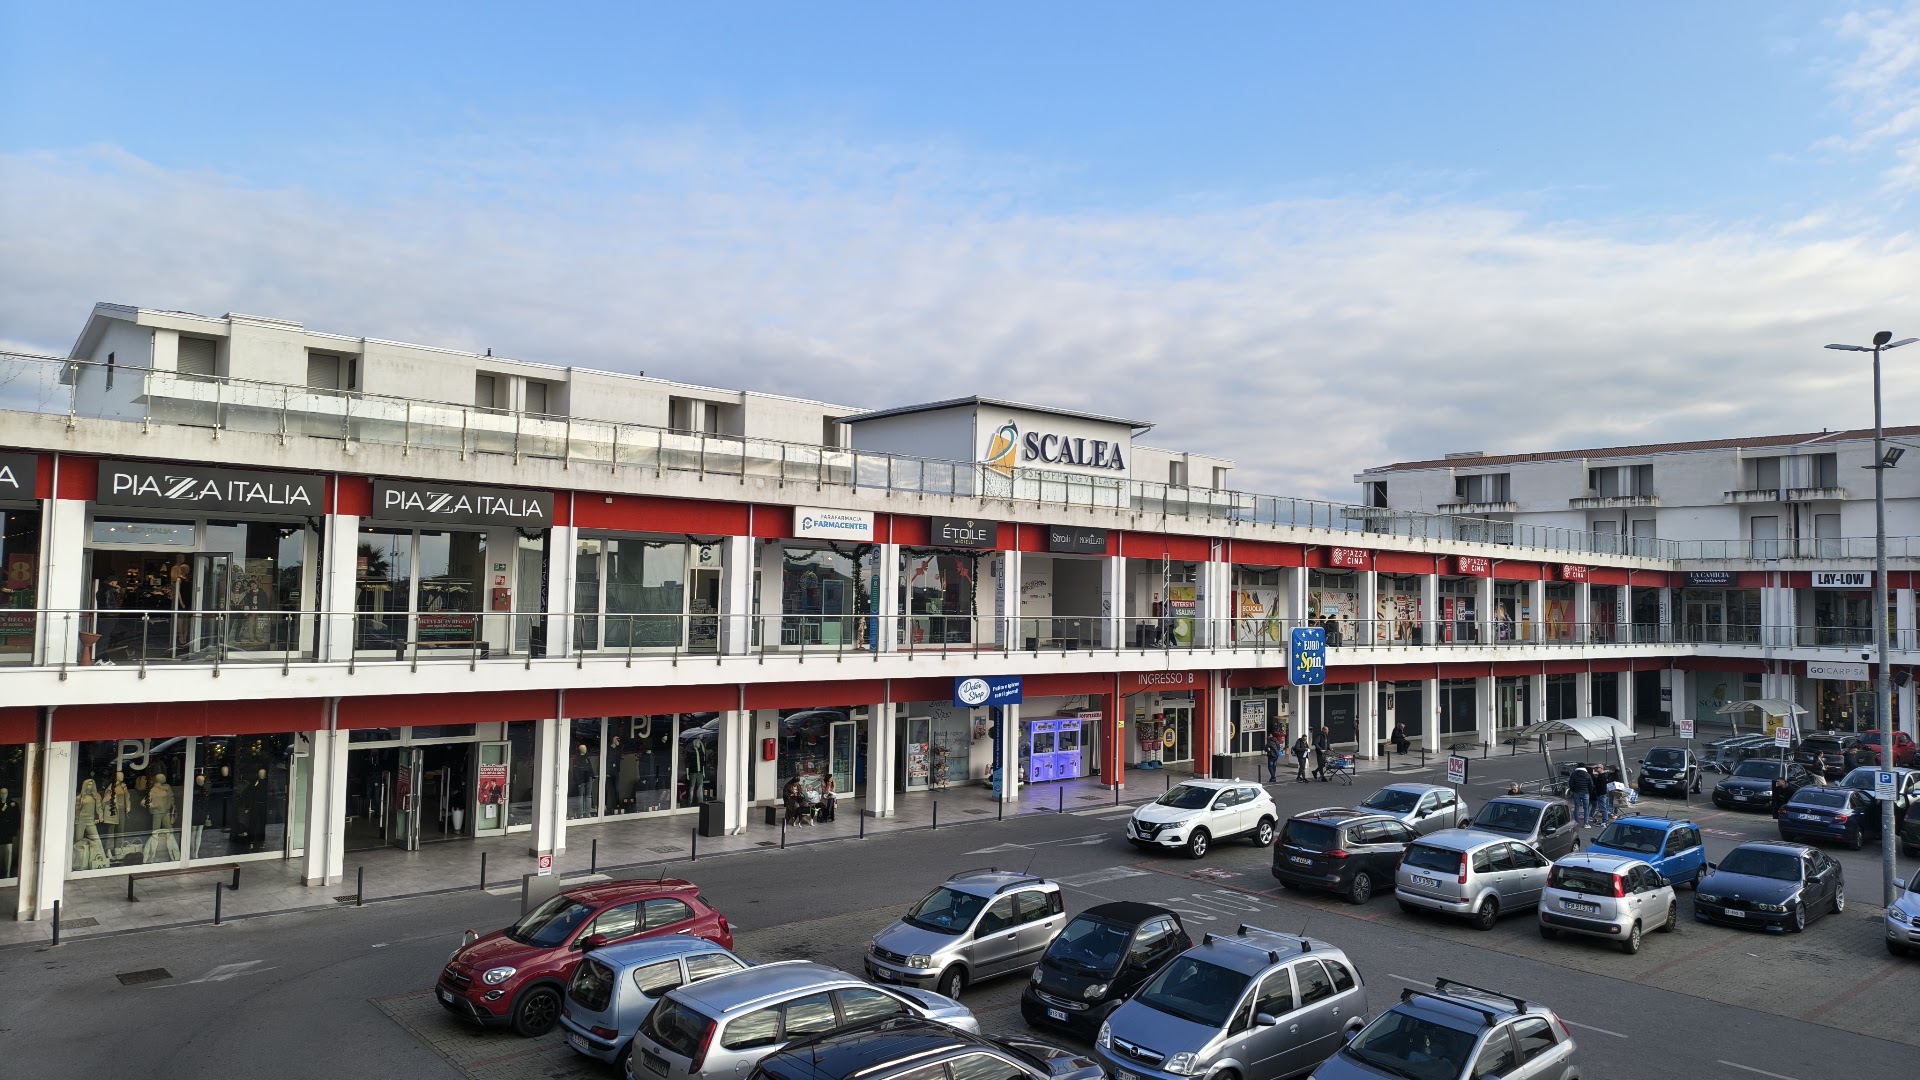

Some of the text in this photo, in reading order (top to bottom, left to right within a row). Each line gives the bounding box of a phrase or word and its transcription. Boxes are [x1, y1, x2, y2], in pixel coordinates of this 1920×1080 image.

[1022, 431, 1126, 470] SCALEA
[1028, 469, 1127, 488] SHOPPNG VLLAGE
[113, 473, 311, 506] PIAZZA ITALIA
[385, 489, 543, 518] PIAZZA ITALIA
[820, 514, 862, 522] PARAFARMACIA
[813, 520, 868, 530] FARMACENTER
[943, 523, 987, 541] ÉTOILE
[1342, 549, 1368, 558] PIAZZA
[1347, 557, 1364, 565] CINA
[1467, 558, 1488, 566] PIAZZA
[12, 561, 31, 582] 8
[1471, 565, 1485, 573] CINA
[1570, 565, 1587, 573] PIAZZA
[1818, 573, 1865, 585] LAY-LOW
[1242, 604, 1263, 612] SCUOLA
[1303, 640, 1320, 651] EURO
[1138, 673, 1194, 685] INGRESSO B
[968, 691, 985, 702] Shop
[1881, 774, 1890, 782] P
